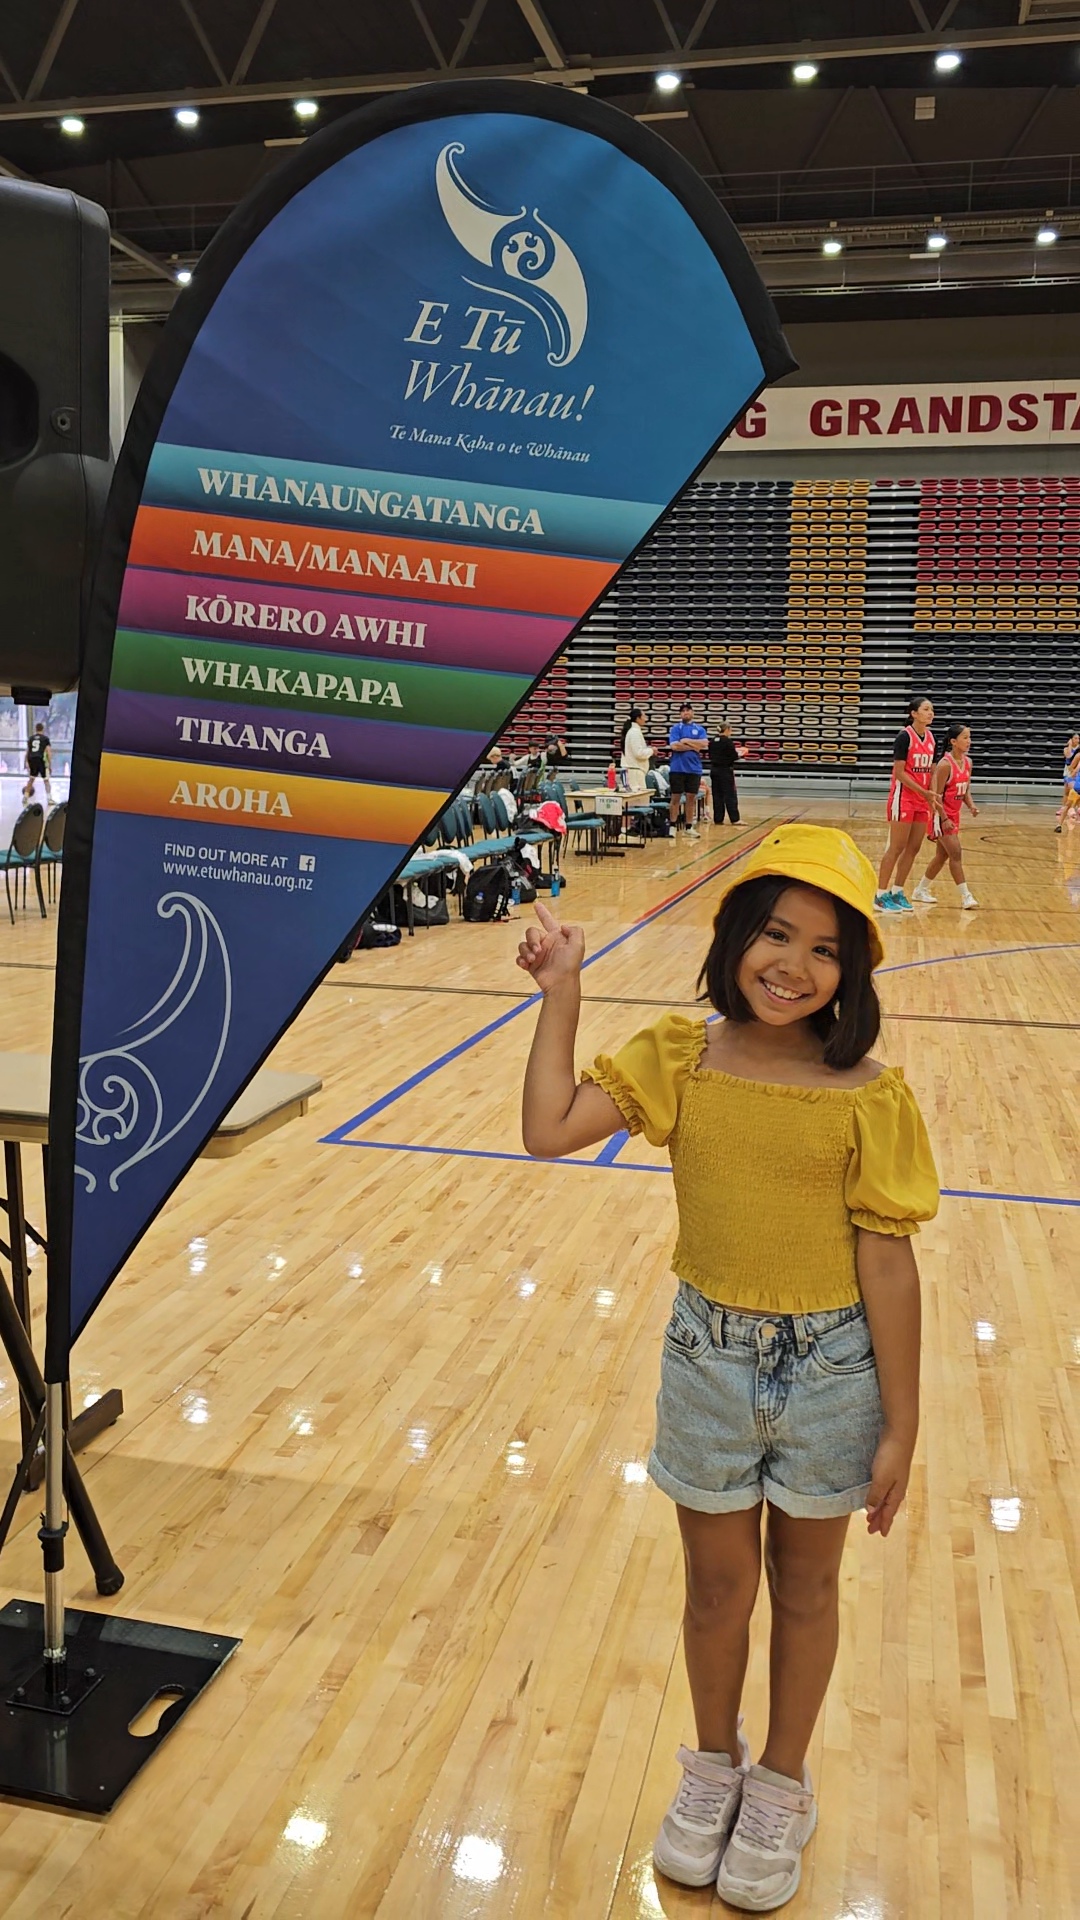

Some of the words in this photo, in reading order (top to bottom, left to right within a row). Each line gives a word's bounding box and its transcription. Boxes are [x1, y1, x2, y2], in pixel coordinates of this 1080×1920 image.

[403, 301, 449, 345] E
[460, 306, 525, 355] Tū
[404, 360, 595, 422] Whānau!
[389, 424, 407, 440] Te
[408, 427, 452, 447] Mana
[454, 433, 494, 453] Kaha
[496, 442, 506, 452] o
[508, 442, 523, 454] te
[526, 442, 591, 463] Whānau
[196, 467, 545, 535] WHANAUNGATANGA
[190, 529, 479, 589] MANA/MANAAKI
[184, 593, 327, 636] KŌRERO
[330, 613, 428, 648] AWHI
[181, 656, 404, 708] WHAKAPAPA
[175, 715, 332, 759] TIKANGA
[169, 780, 293, 818] AROHA
[163, 861, 314, 892] www.etuwhanau.org.nz
[164, 842, 196, 858] FIND
[198, 847, 227, 862] OUT
[229, 851, 268, 867] MORE
[271, 856, 288, 869] AT
